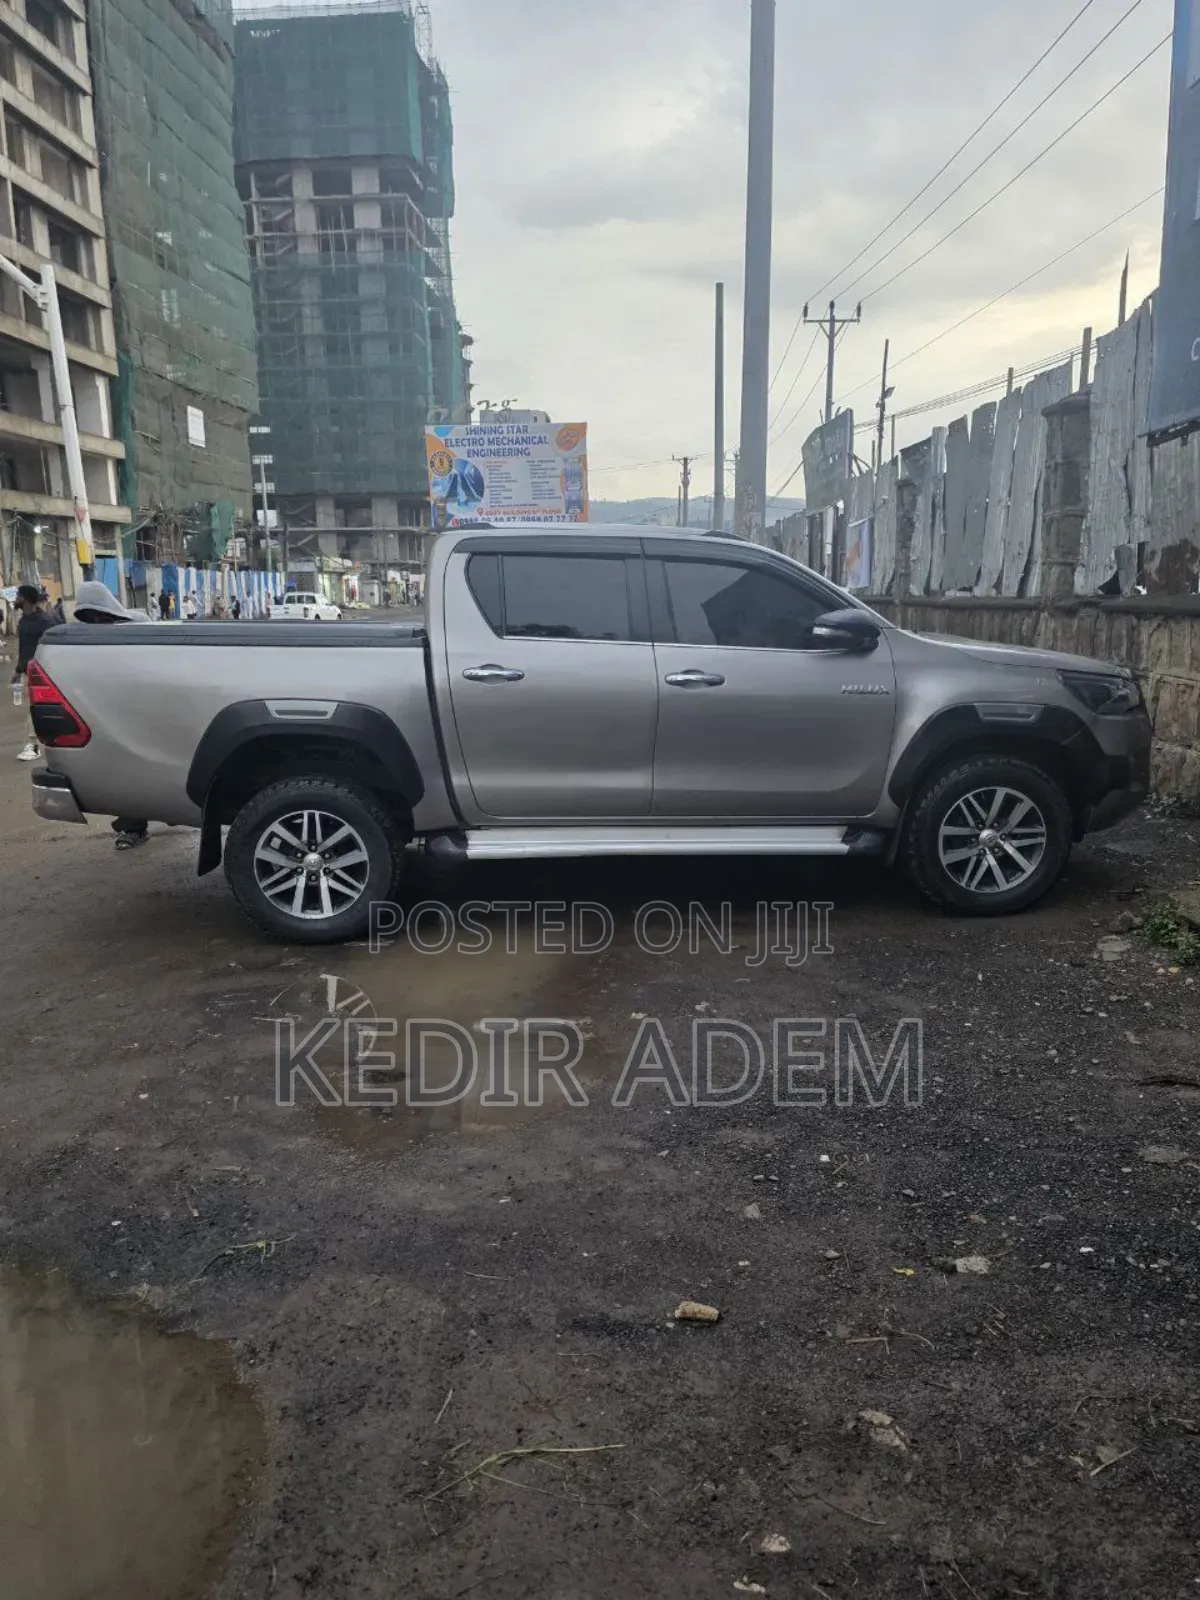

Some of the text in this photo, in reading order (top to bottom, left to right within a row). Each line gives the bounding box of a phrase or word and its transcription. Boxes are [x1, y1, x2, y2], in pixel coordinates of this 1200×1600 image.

[464, 425, 529, 436] SHINING STAR
[444, 438, 486, 448] ELECTRO
[487, 436, 549, 447] MECHANICAL
[467, 447, 531, 458] ENGINEERING
